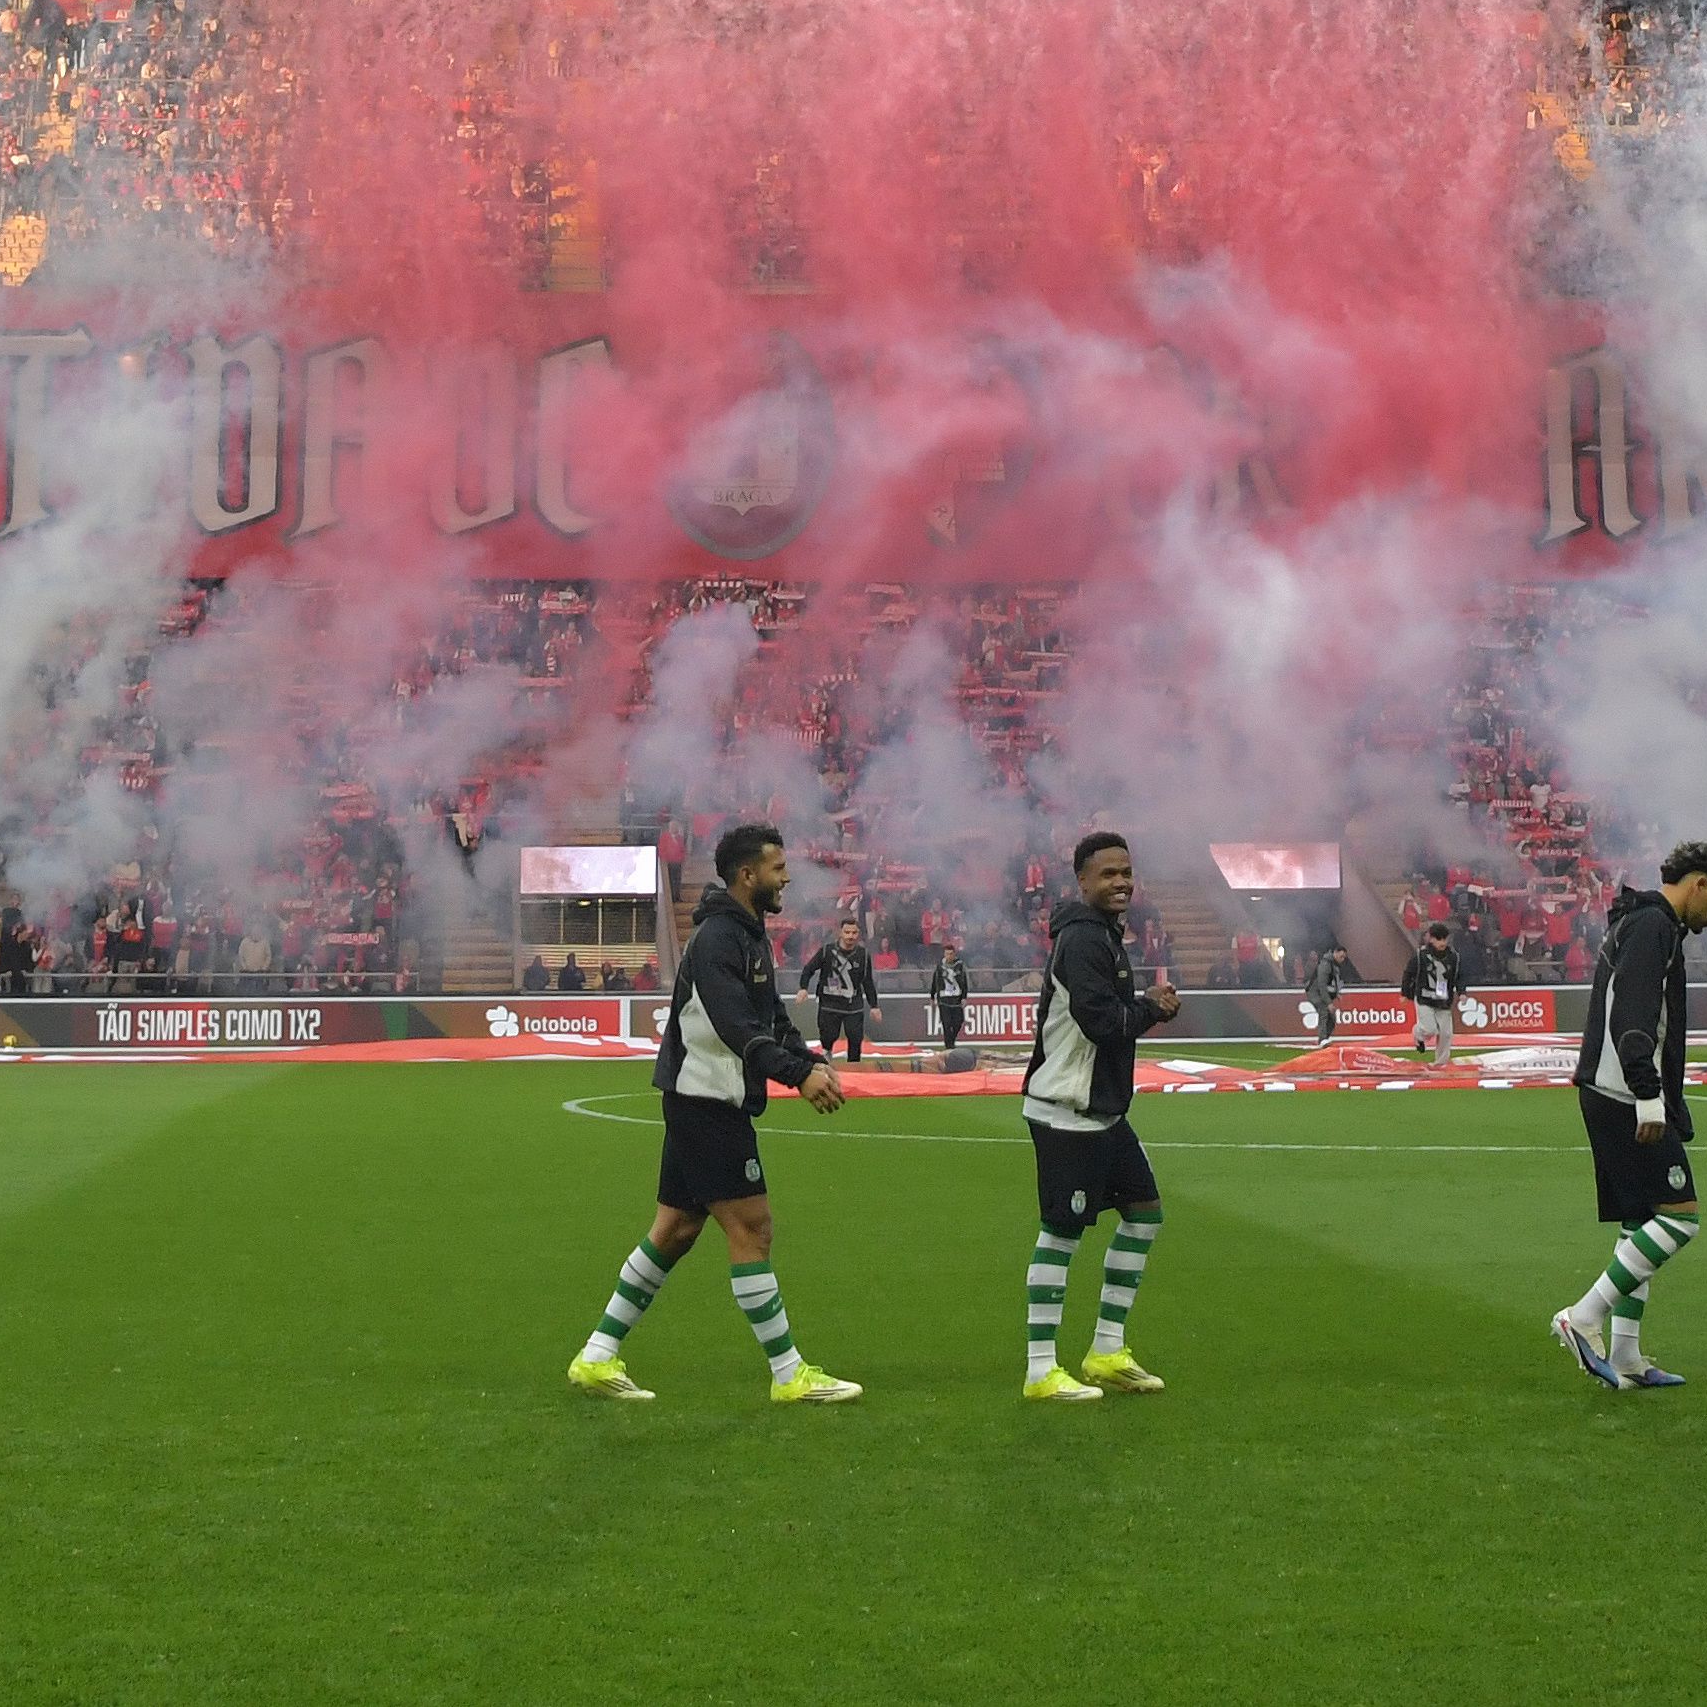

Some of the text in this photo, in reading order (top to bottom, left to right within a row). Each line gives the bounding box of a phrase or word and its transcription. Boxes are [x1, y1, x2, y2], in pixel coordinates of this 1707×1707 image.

[96, 1002, 321, 1042] TÃO SIMPLES COMO 1X2
[1335, 1008, 1406, 1024] totobola
[1491, 1001, 1544, 1024] JOGOS
[524, 1015, 597, 1033] totobola
